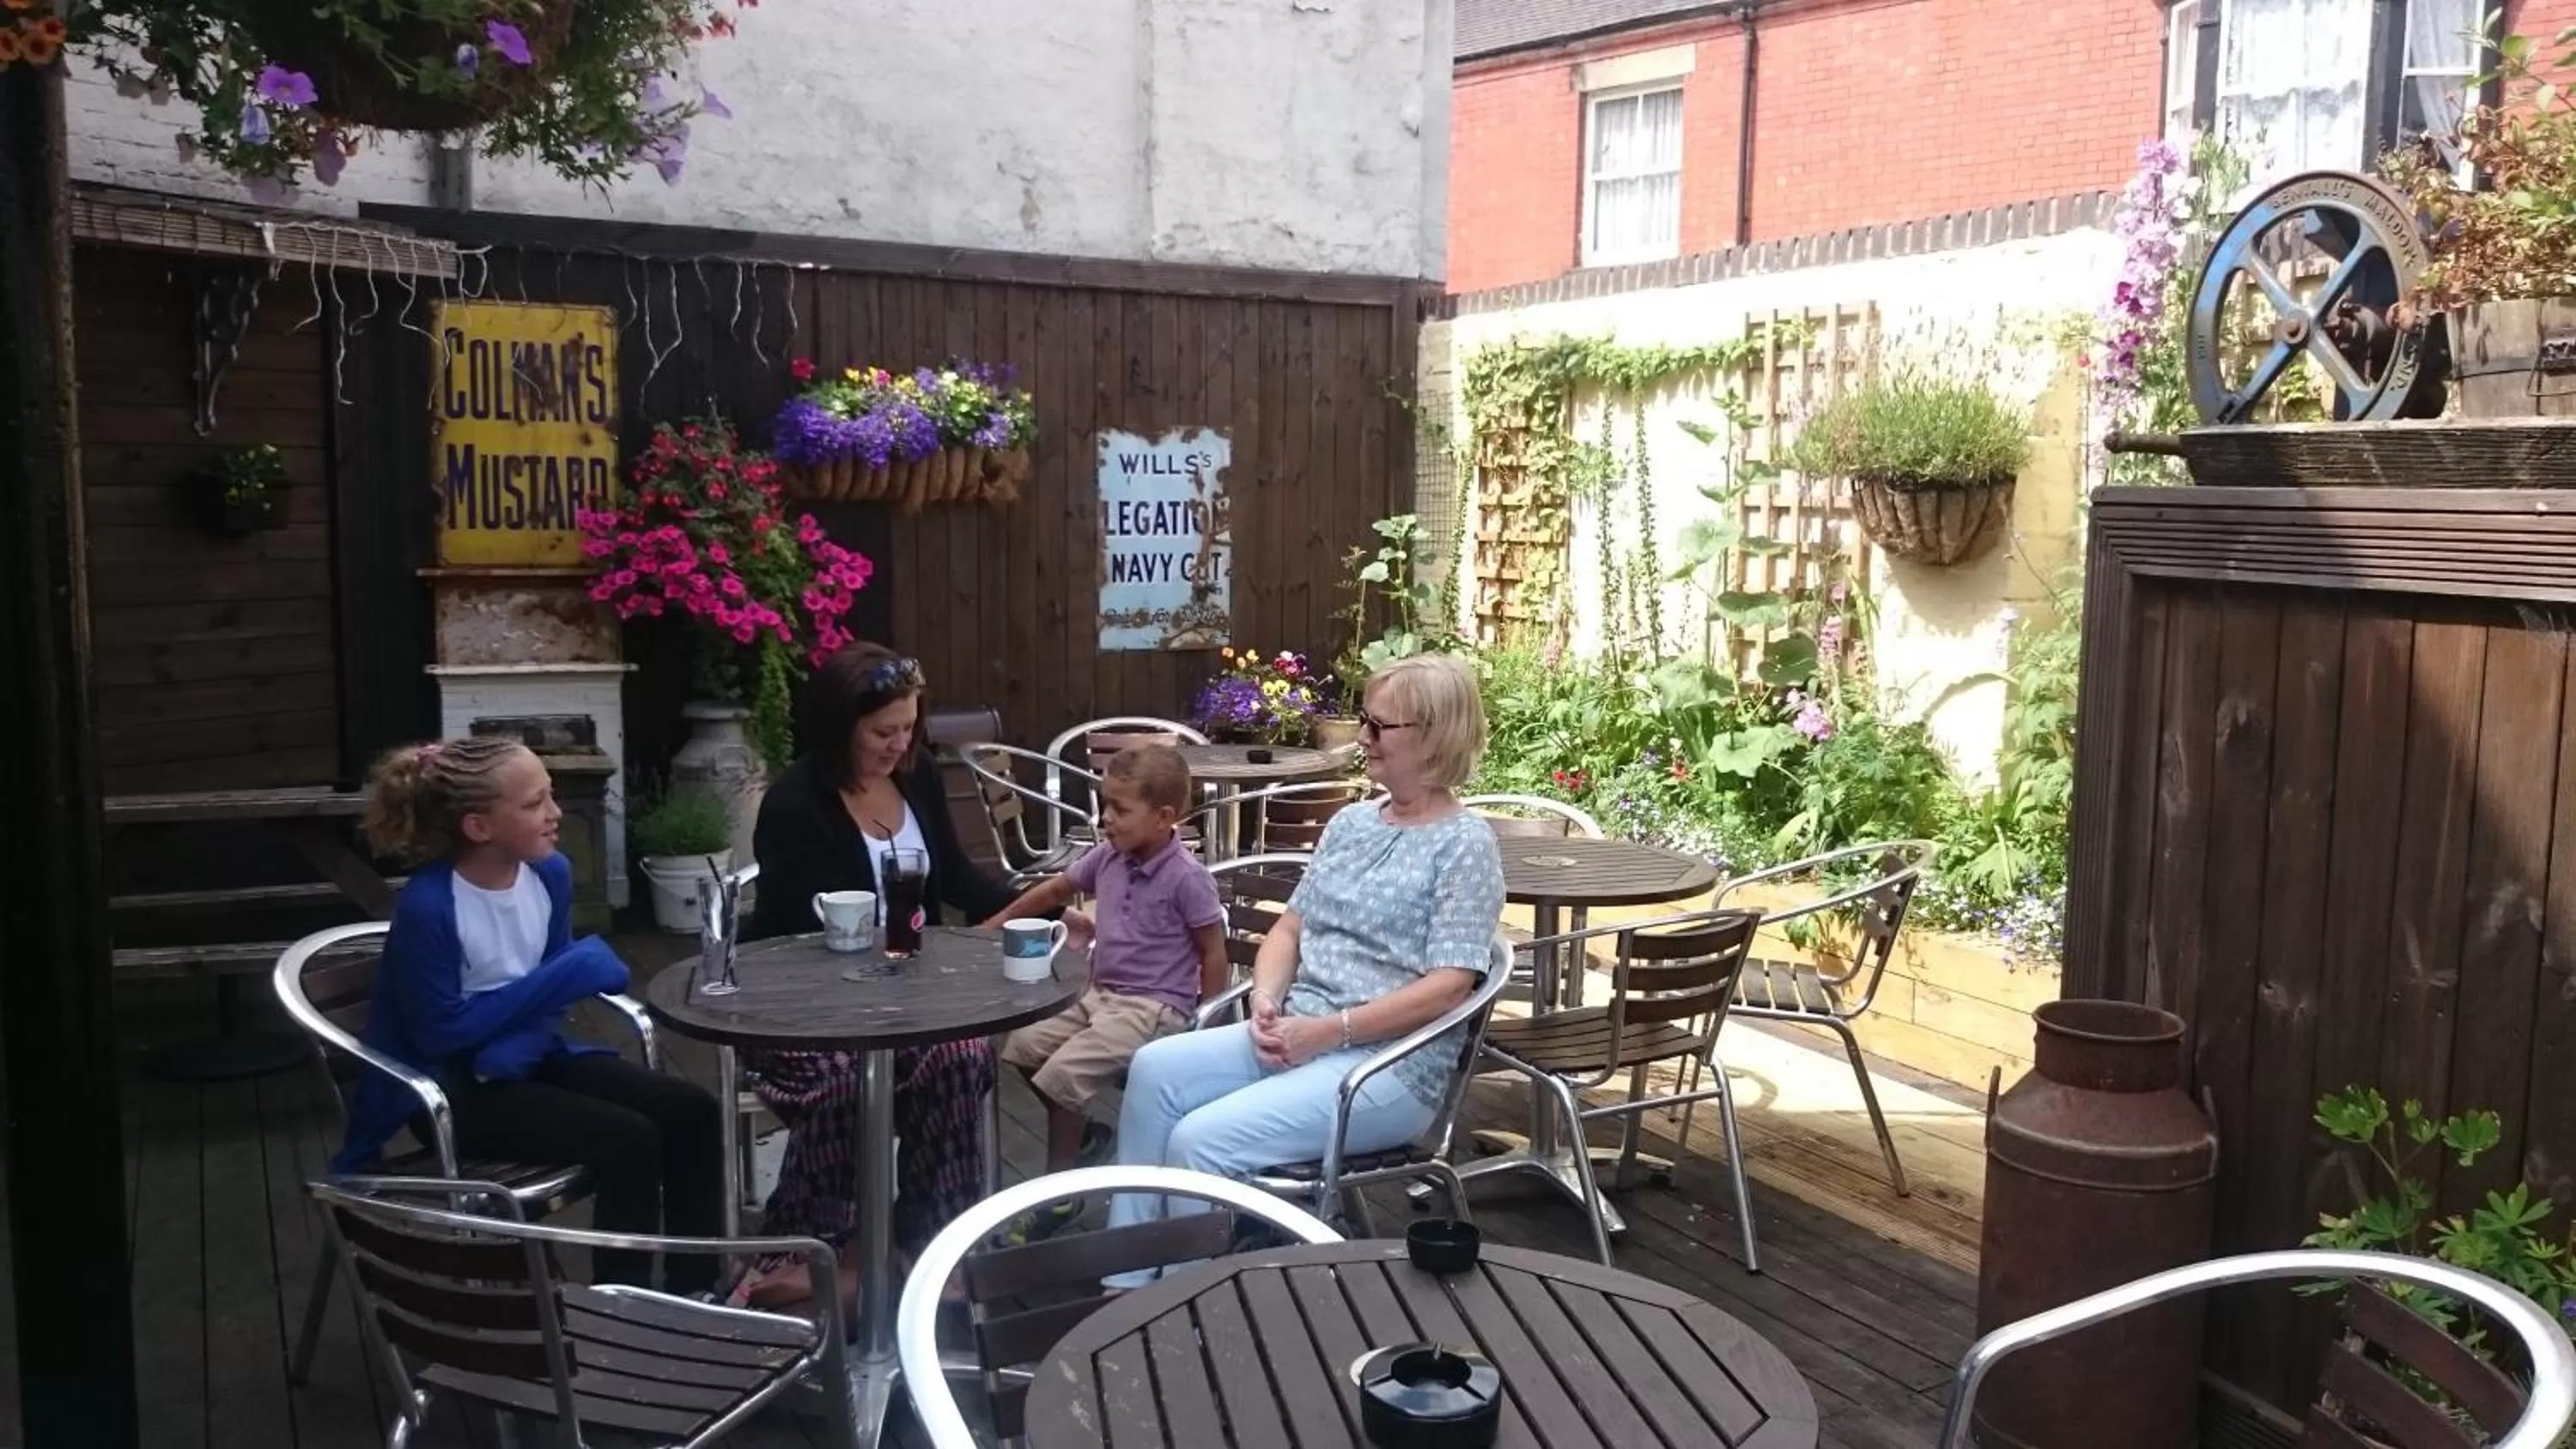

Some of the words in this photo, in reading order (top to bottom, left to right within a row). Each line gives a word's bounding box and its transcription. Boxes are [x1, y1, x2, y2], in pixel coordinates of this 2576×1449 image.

[2363, 190, 2417, 269] MALDON
[447, 443, 611, 530] MUSTARD
[1111, 553, 1174, 583] NAVY
